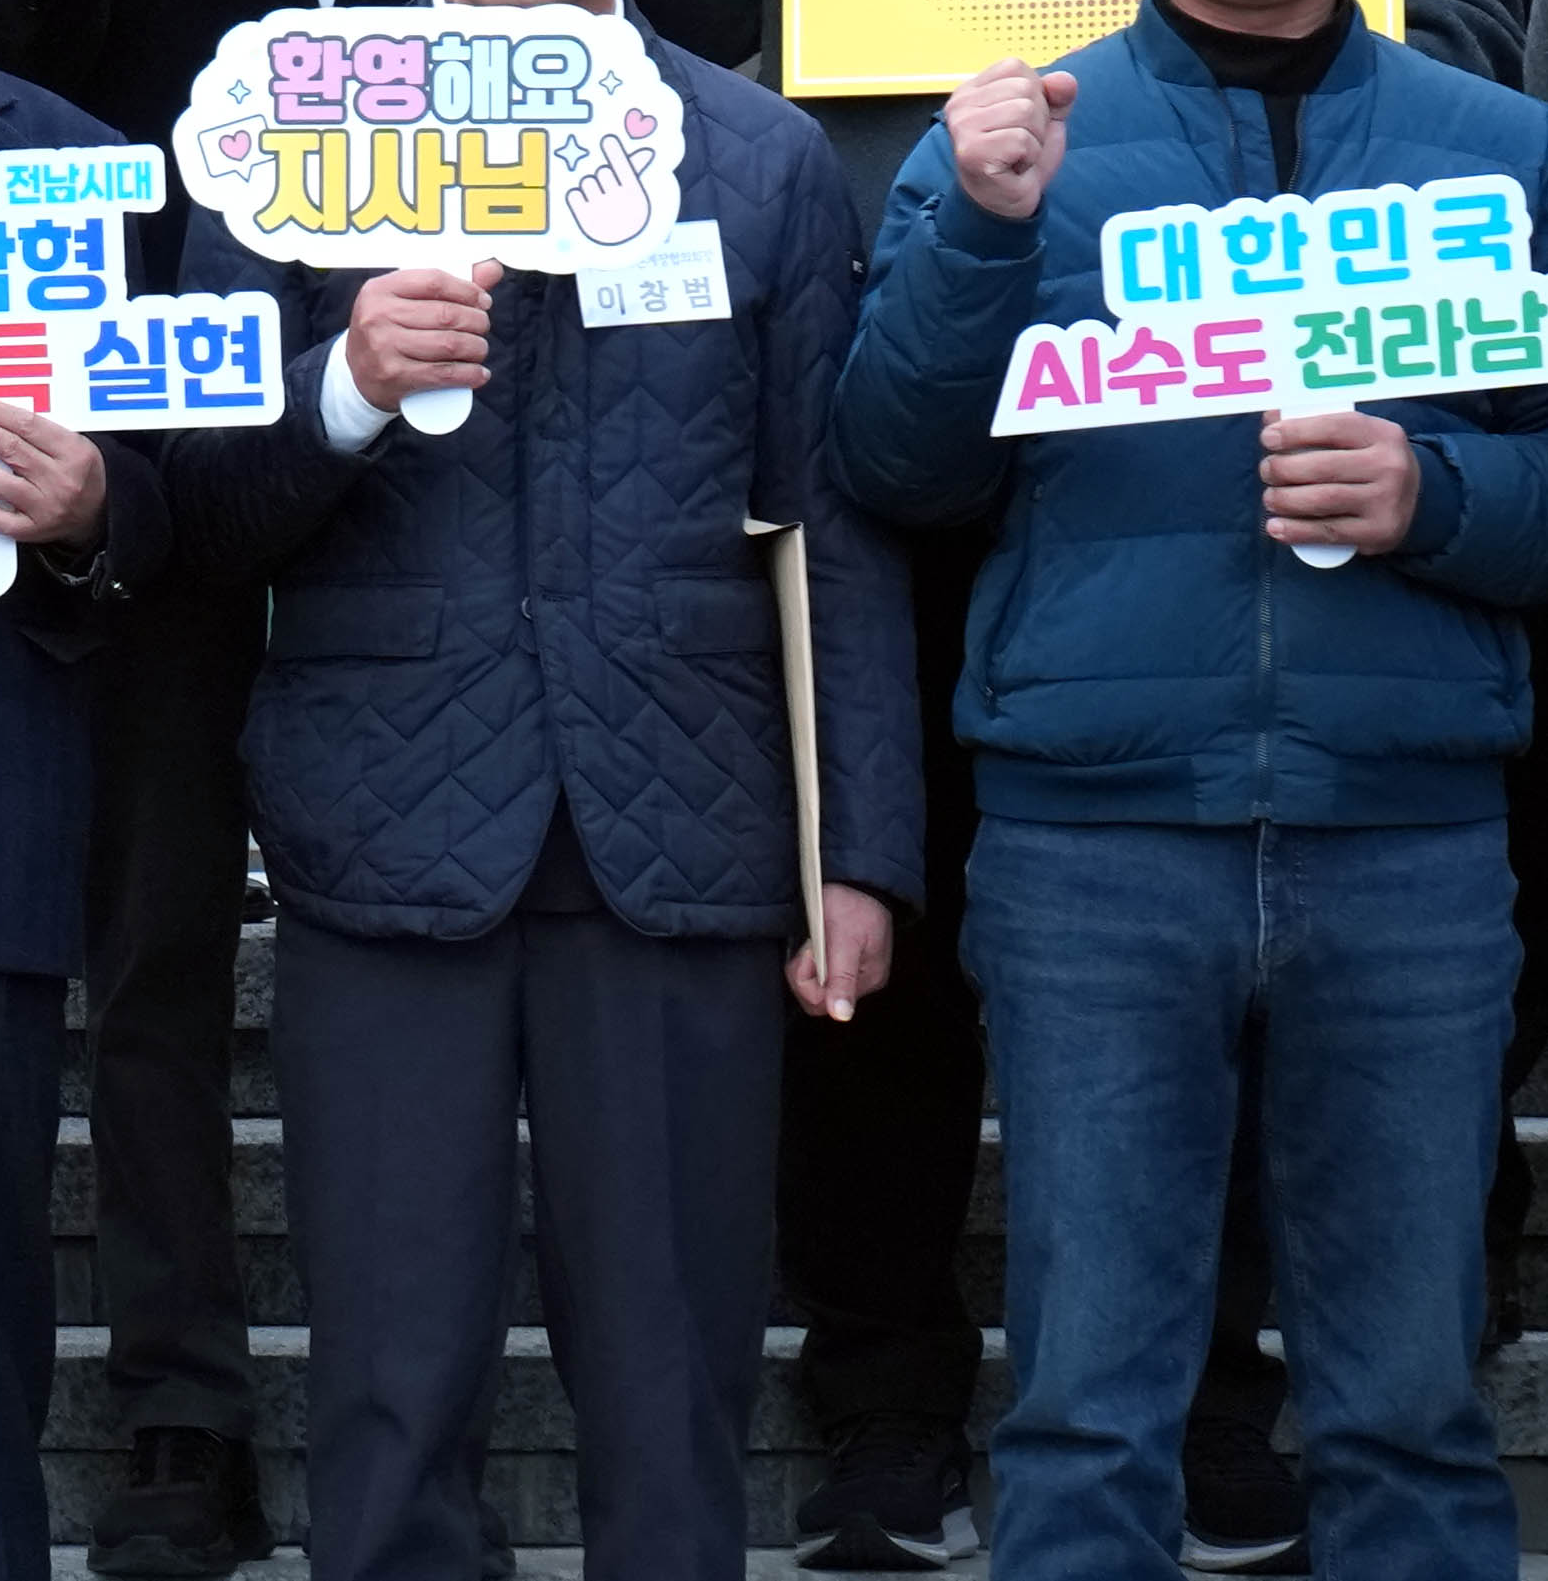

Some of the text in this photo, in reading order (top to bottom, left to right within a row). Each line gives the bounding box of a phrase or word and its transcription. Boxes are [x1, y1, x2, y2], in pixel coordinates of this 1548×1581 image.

[268, 31, 593, 124] 환영해요
[6, 160, 152, 204] 전남시대
[253, 128, 550, 235] 지사님
[84, 315, 266, 412] 실현
[1017, 318, 1273, 411] AI수도
